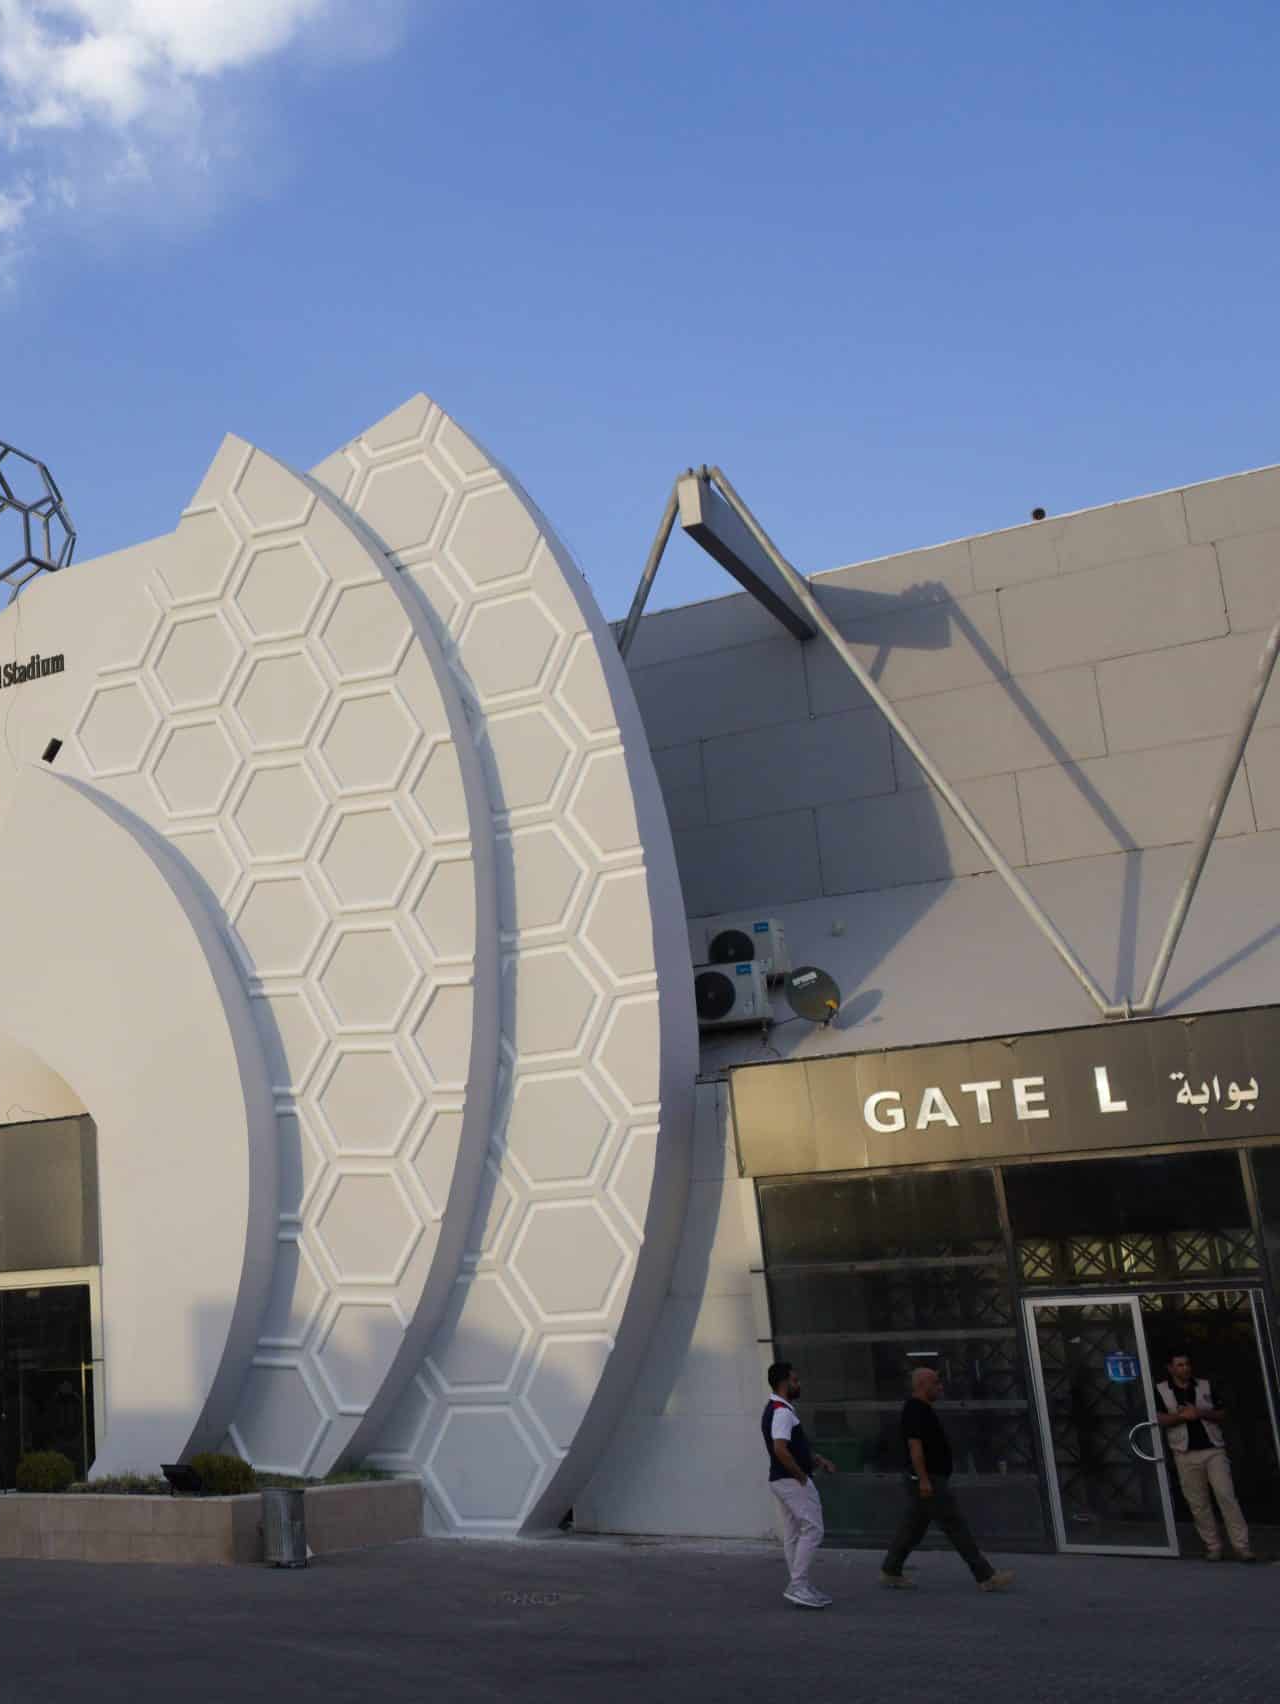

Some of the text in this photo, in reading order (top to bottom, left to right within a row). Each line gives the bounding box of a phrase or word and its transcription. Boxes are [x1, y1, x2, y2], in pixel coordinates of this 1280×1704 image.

[2, 653, 65, 688] Stadium
[863, 1065, 1129, 1134] GATE L
[1168, 1070, 1260, 1114] بوابة
